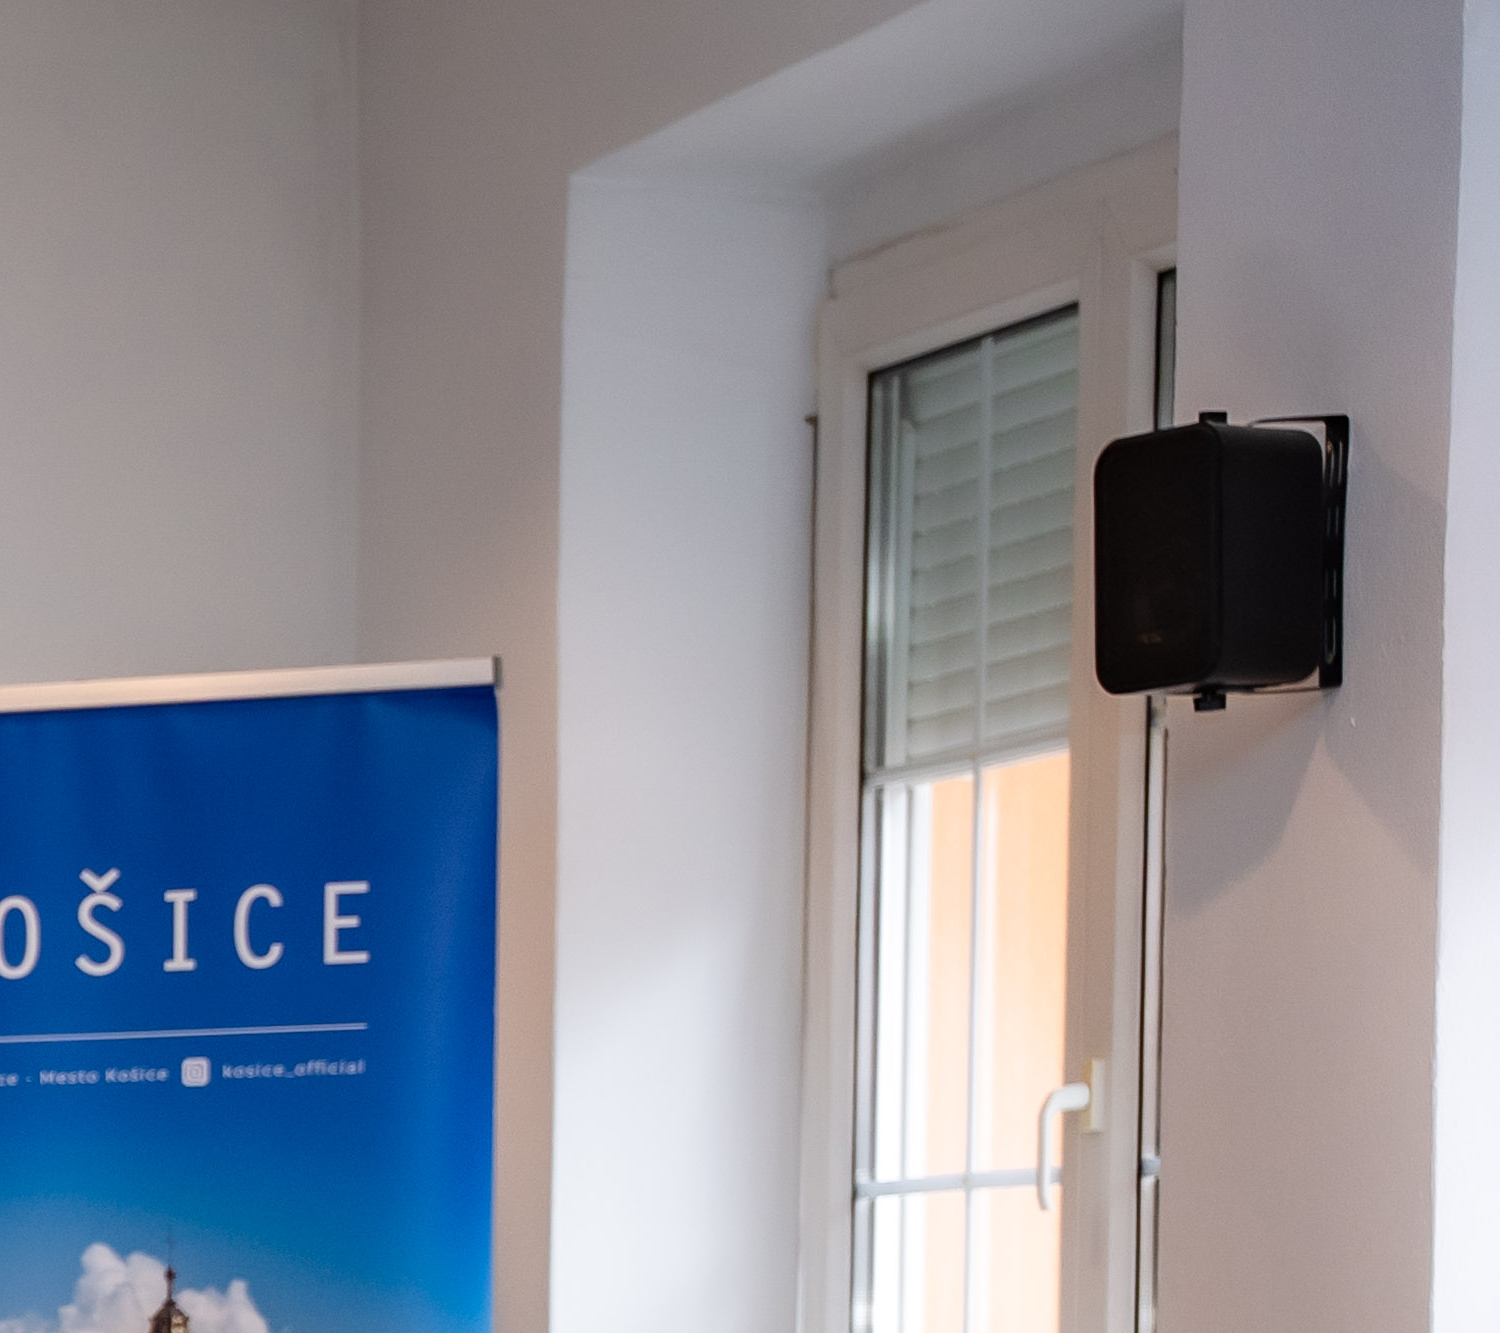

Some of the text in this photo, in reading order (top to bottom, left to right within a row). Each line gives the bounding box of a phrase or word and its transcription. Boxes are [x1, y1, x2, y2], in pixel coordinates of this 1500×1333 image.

[39, 1069, 99, 1086] Mesto
[105, 1066, 170, 1083] Košice
[222, 1058, 367, 1080] kosice_official
